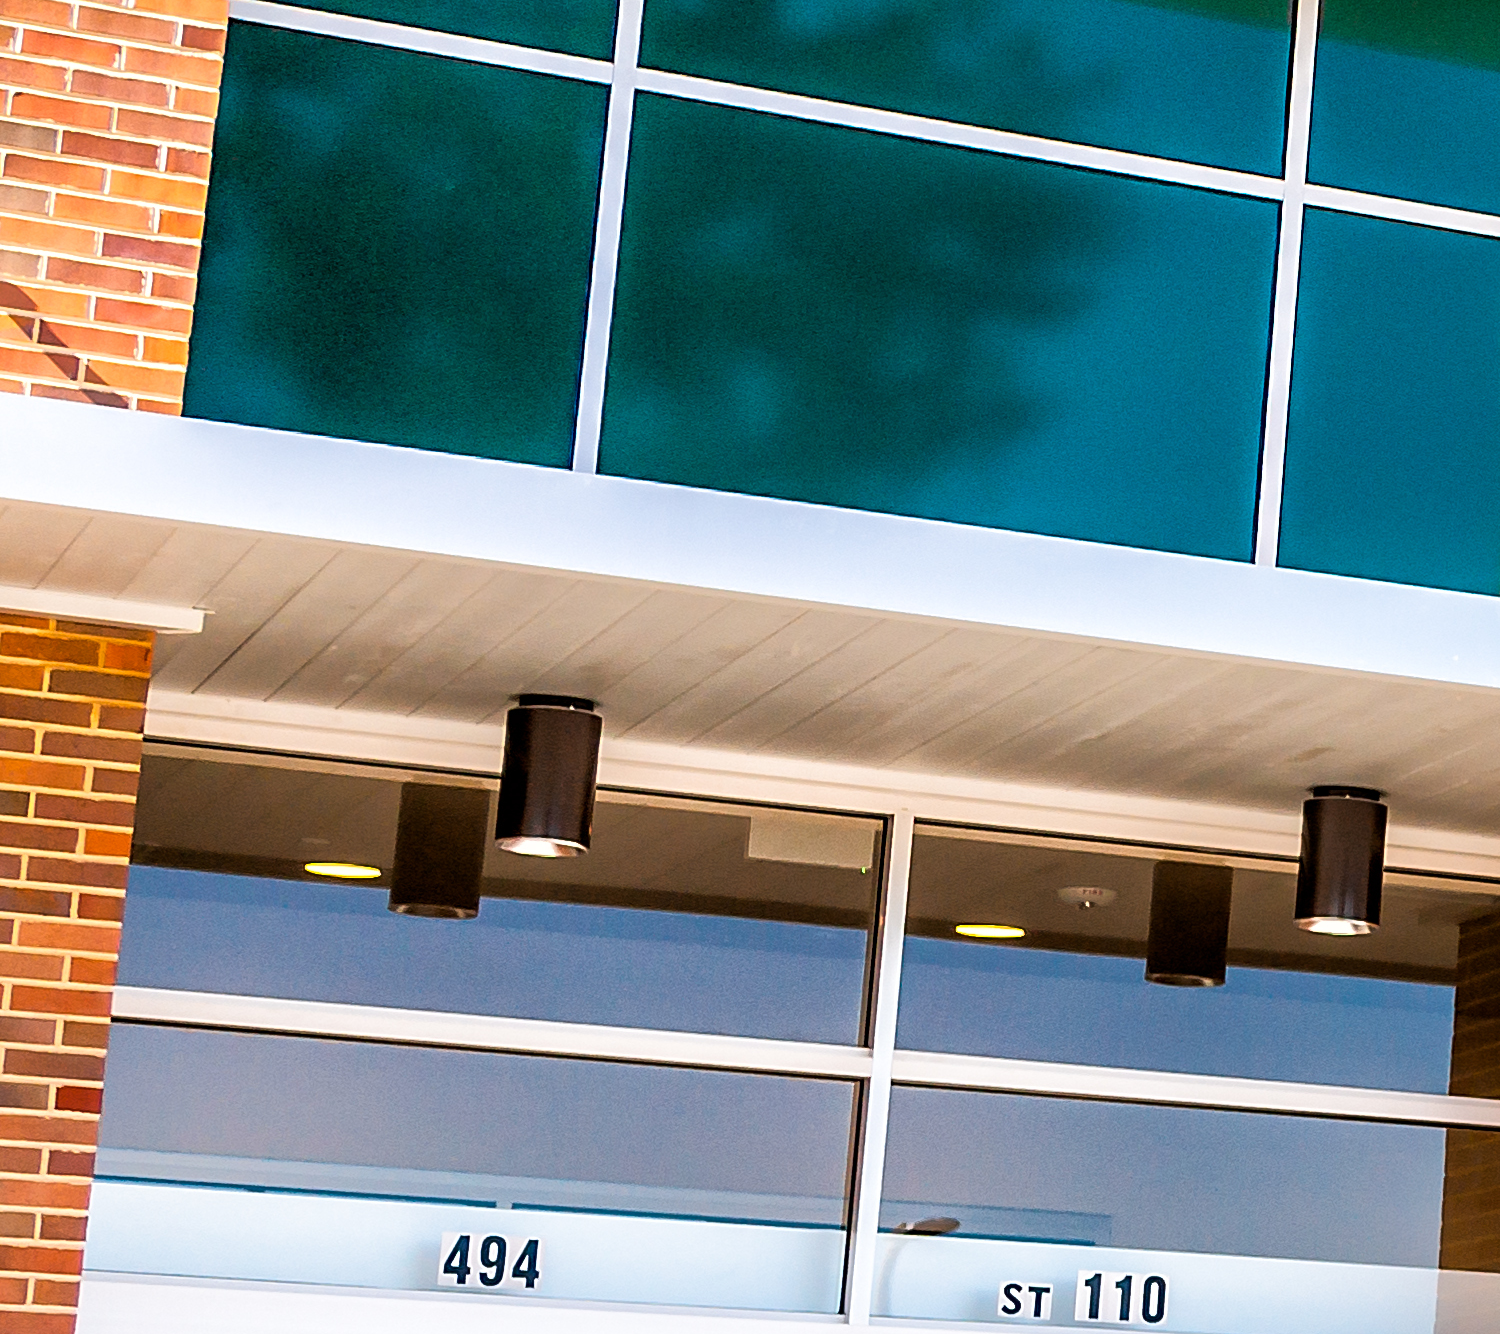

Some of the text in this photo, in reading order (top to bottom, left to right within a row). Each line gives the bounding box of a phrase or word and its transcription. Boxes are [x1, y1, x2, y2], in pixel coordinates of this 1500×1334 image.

[441, 1234, 541, 1290] 494
[1001, 1272, 1168, 1324] ST 110
